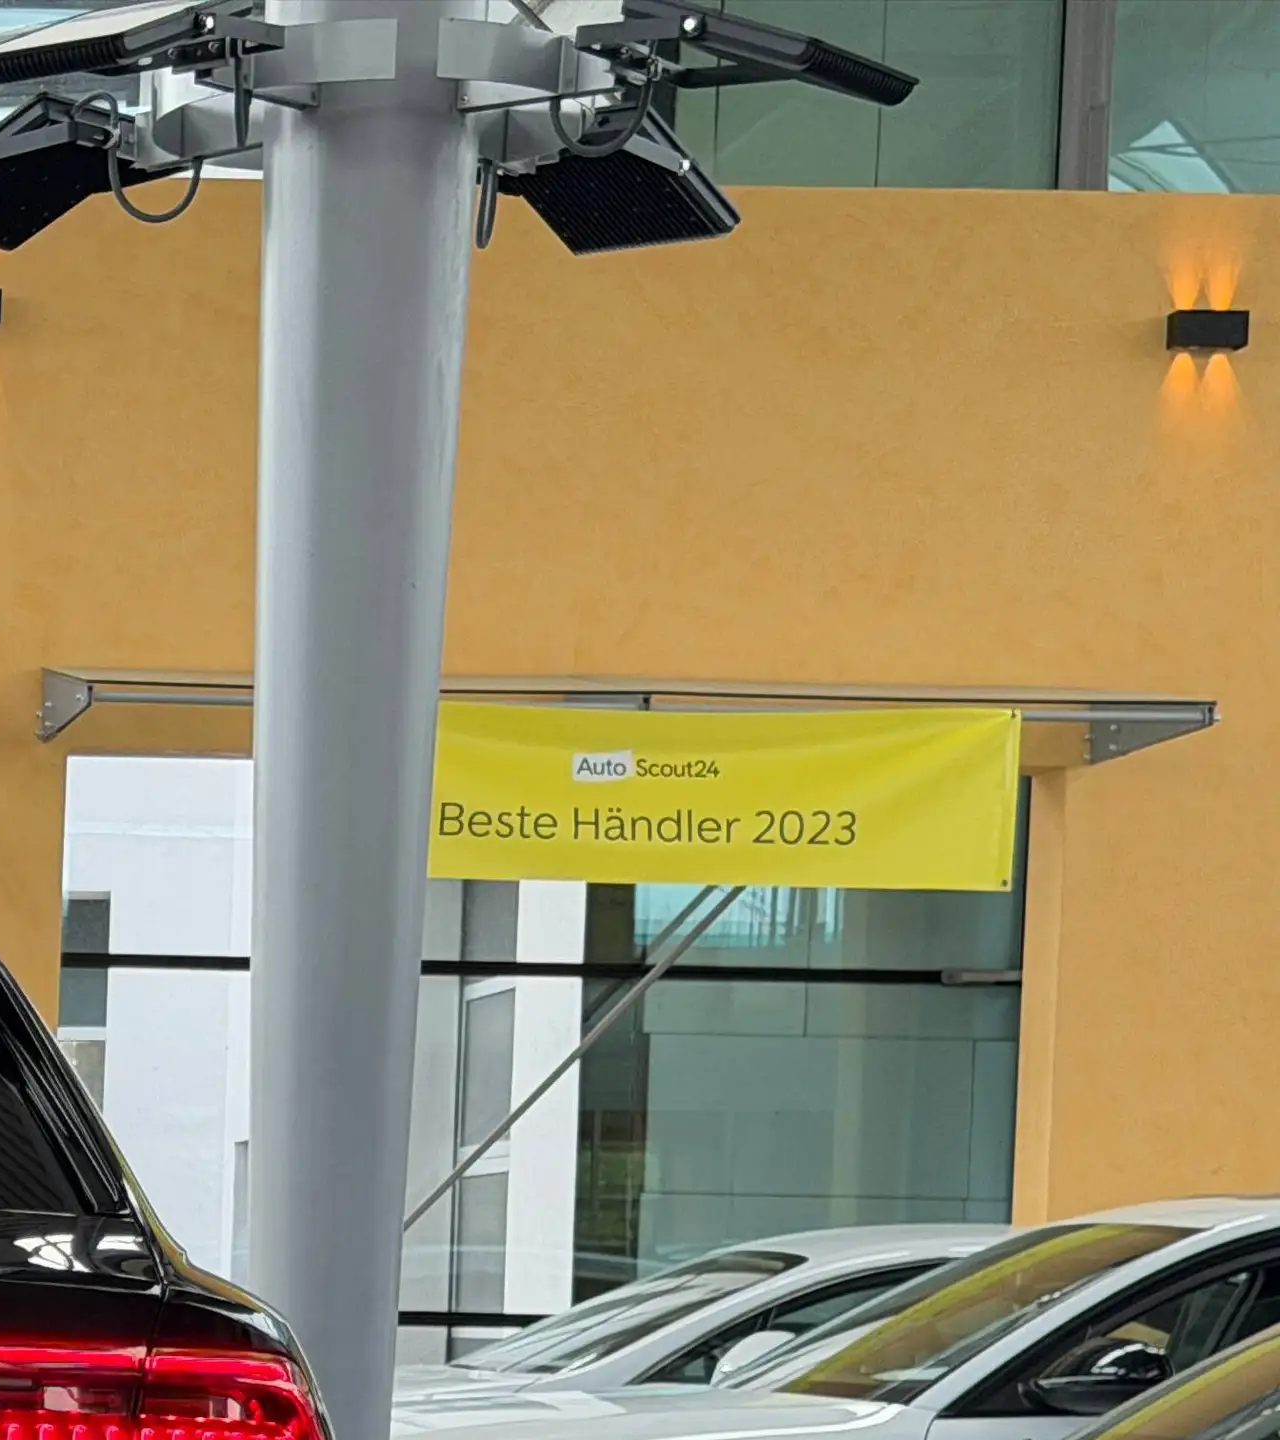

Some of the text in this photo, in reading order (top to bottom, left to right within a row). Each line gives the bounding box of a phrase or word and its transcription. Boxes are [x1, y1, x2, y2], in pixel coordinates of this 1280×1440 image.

[576, 757, 721, 778] Auto Scout24
[438, 802, 857, 846] Beste Händler 2023
